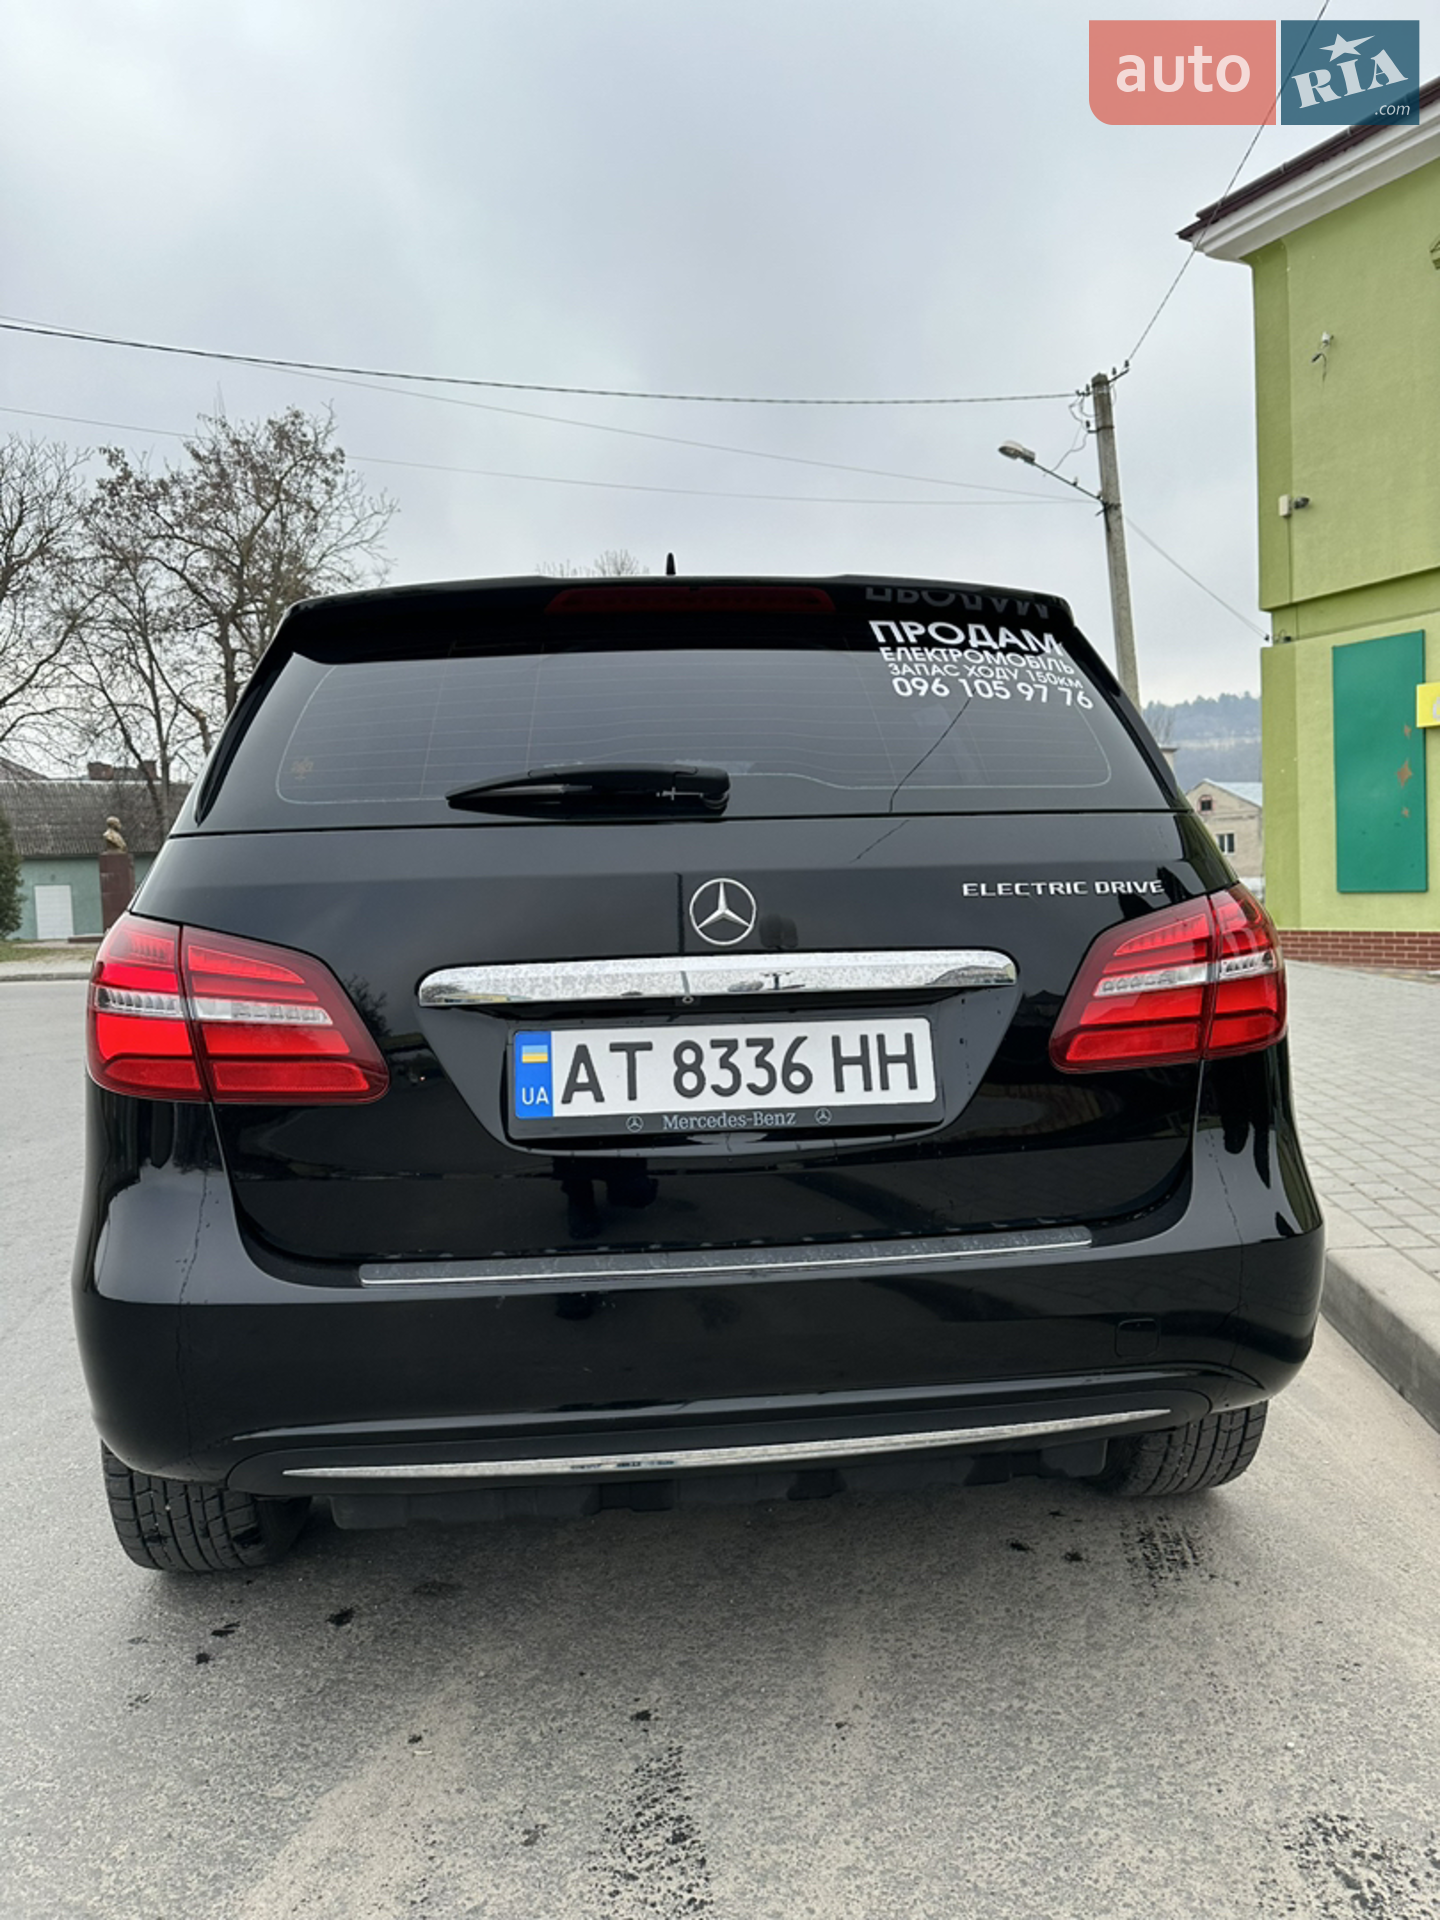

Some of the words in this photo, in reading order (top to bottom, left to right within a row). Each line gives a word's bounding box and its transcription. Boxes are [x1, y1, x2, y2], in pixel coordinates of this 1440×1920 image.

[868, 620, 1063, 656] ПРОДАМ
[879, 646, 1076, 675] ЕЛЕКТРОМОБІЛЬ
[888, 663, 960, 677] ЗАПАС
[963, 664, 1019, 681] ХОДУ
[892, 677, 950, 697] 096
[958, 678, 1011, 700] 105
[1016, 682, 1048, 703] 97
[1057, 687, 1094, 710] 76
[962, 881, 1089, 897] ELECTRIC
[1094, 880, 1165, 894] DRIVE
[561, 1041, 654, 1105] AT
[672, 1035, 814, 1099] 8336
[831, 1032, 919, 1093] HH
[522, 1088, 550, 1106] UA
[662, 1111, 797, 1130] Mercedes-Benz
